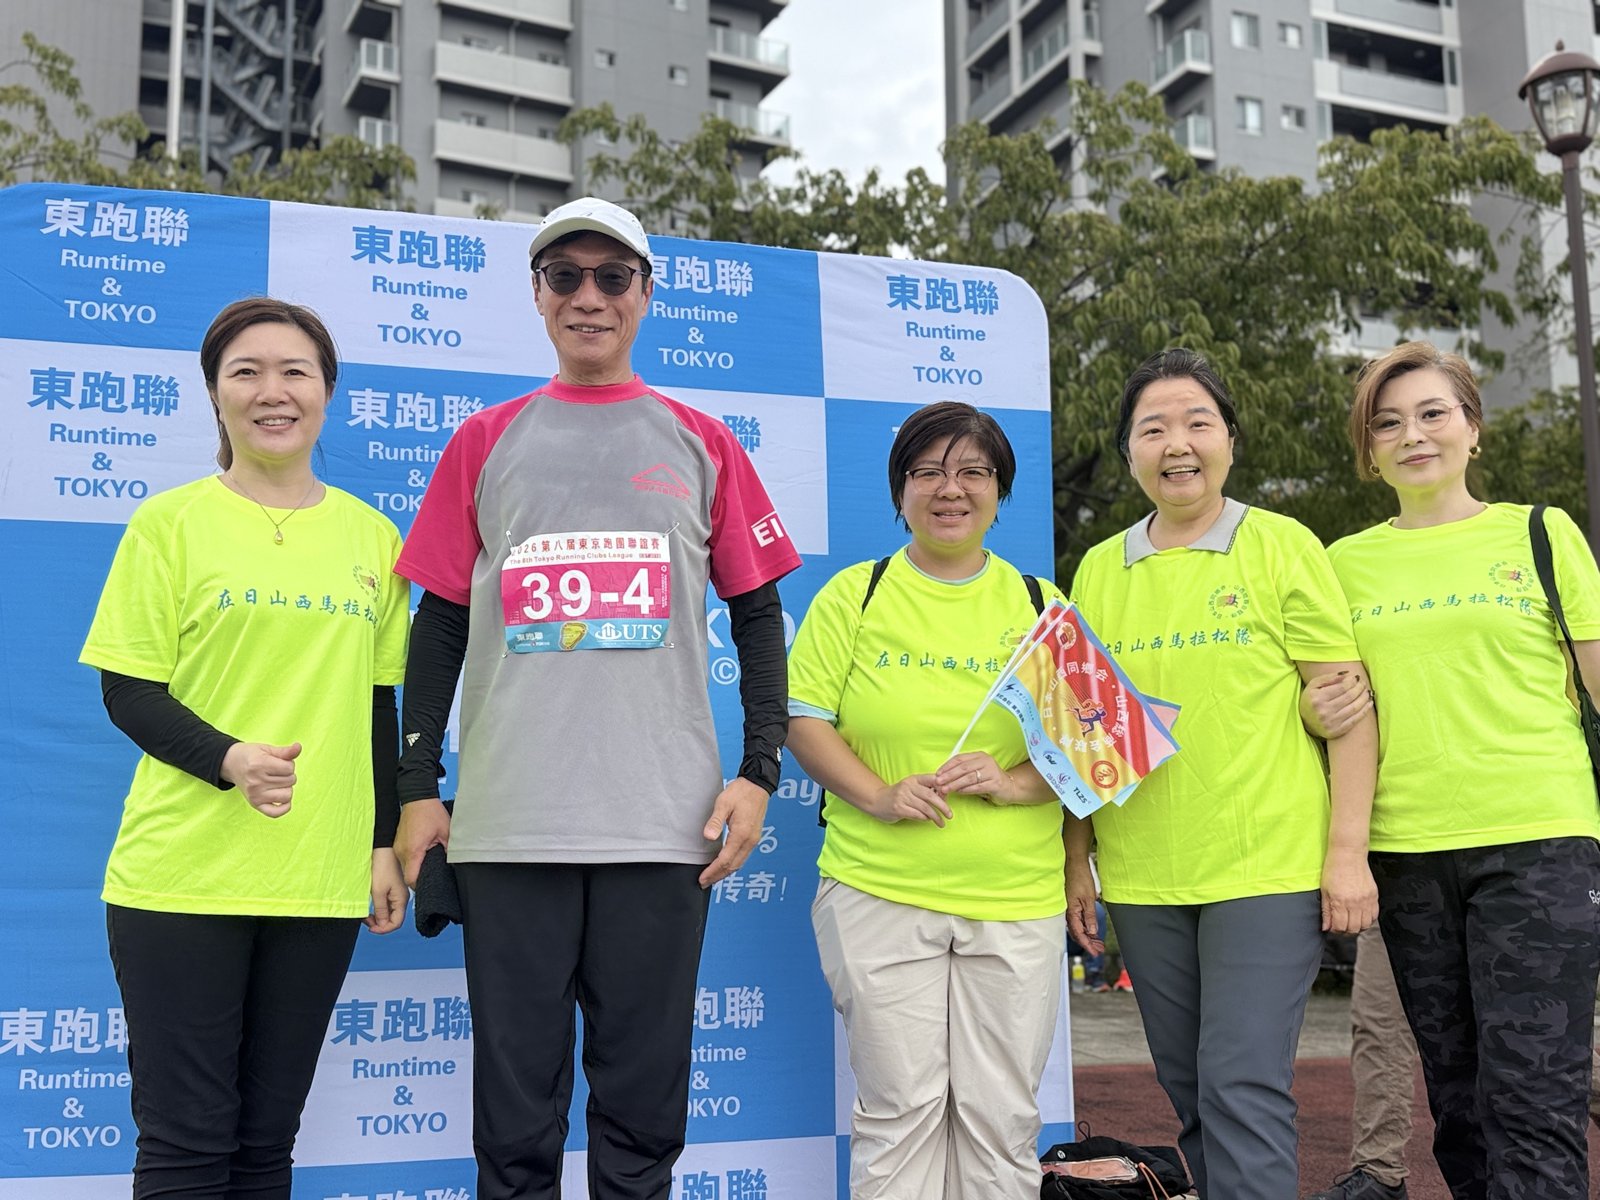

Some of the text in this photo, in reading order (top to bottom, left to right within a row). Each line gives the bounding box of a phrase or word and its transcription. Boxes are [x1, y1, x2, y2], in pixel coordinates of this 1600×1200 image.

[40, 198, 190, 247] 東跑聯
[351, 225, 487, 273] 東跑聯
[60, 248, 166, 274] Runtime
[101, 277, 122, 297] &
[372, 275, 468, 300] Runtime
[886, 274, 999, 316] 東跑聯
[64, 299, 157, 324] TOKYO
[410, 303, 430, 321] &
[652, 300, 738, 324] Runtime
[377, 324, 462, 348] TOKYO
[687, 326, 705, 345] &
[906, 321, 986, 342] Runtime
[658, 347, 734, 370] TOKYO
[939, 345, 955, 362] &
[913, 366, 983, 386] TOKYO
[27, 366, 180, 417] 東跑聯
[49, 422, 157, 447] Runtime
[91, 451, 113, 472] &
[54, 476, 148, 500] TOKYO
[407, 468, 427, 488] &
[373, 492, 426, 512] TOK
[534, 555, 555, 563] Tokyo
[556, 552, 586, 562] Running
[521, 567, 655, 620] 39-4
[622, 622, 664, 641] UTS
[875, 650, 1009, 674] 在日山西馬拉
[692, 986, 765, 1030] 跑聯
[330, 996, 473, 1046] 東跑聯
[19, 1067, 132, 1090] Runtime
[352, 1056, 456, 1079] Runtime
[691, 1070, 710, 1090] &
[393, 1085, 414, 1106] &
[62, 1097, 84, 1119] &
[356, 1112, 447, 1137] TOKYO
[23, 1125, 121, 1149] TOKYO
